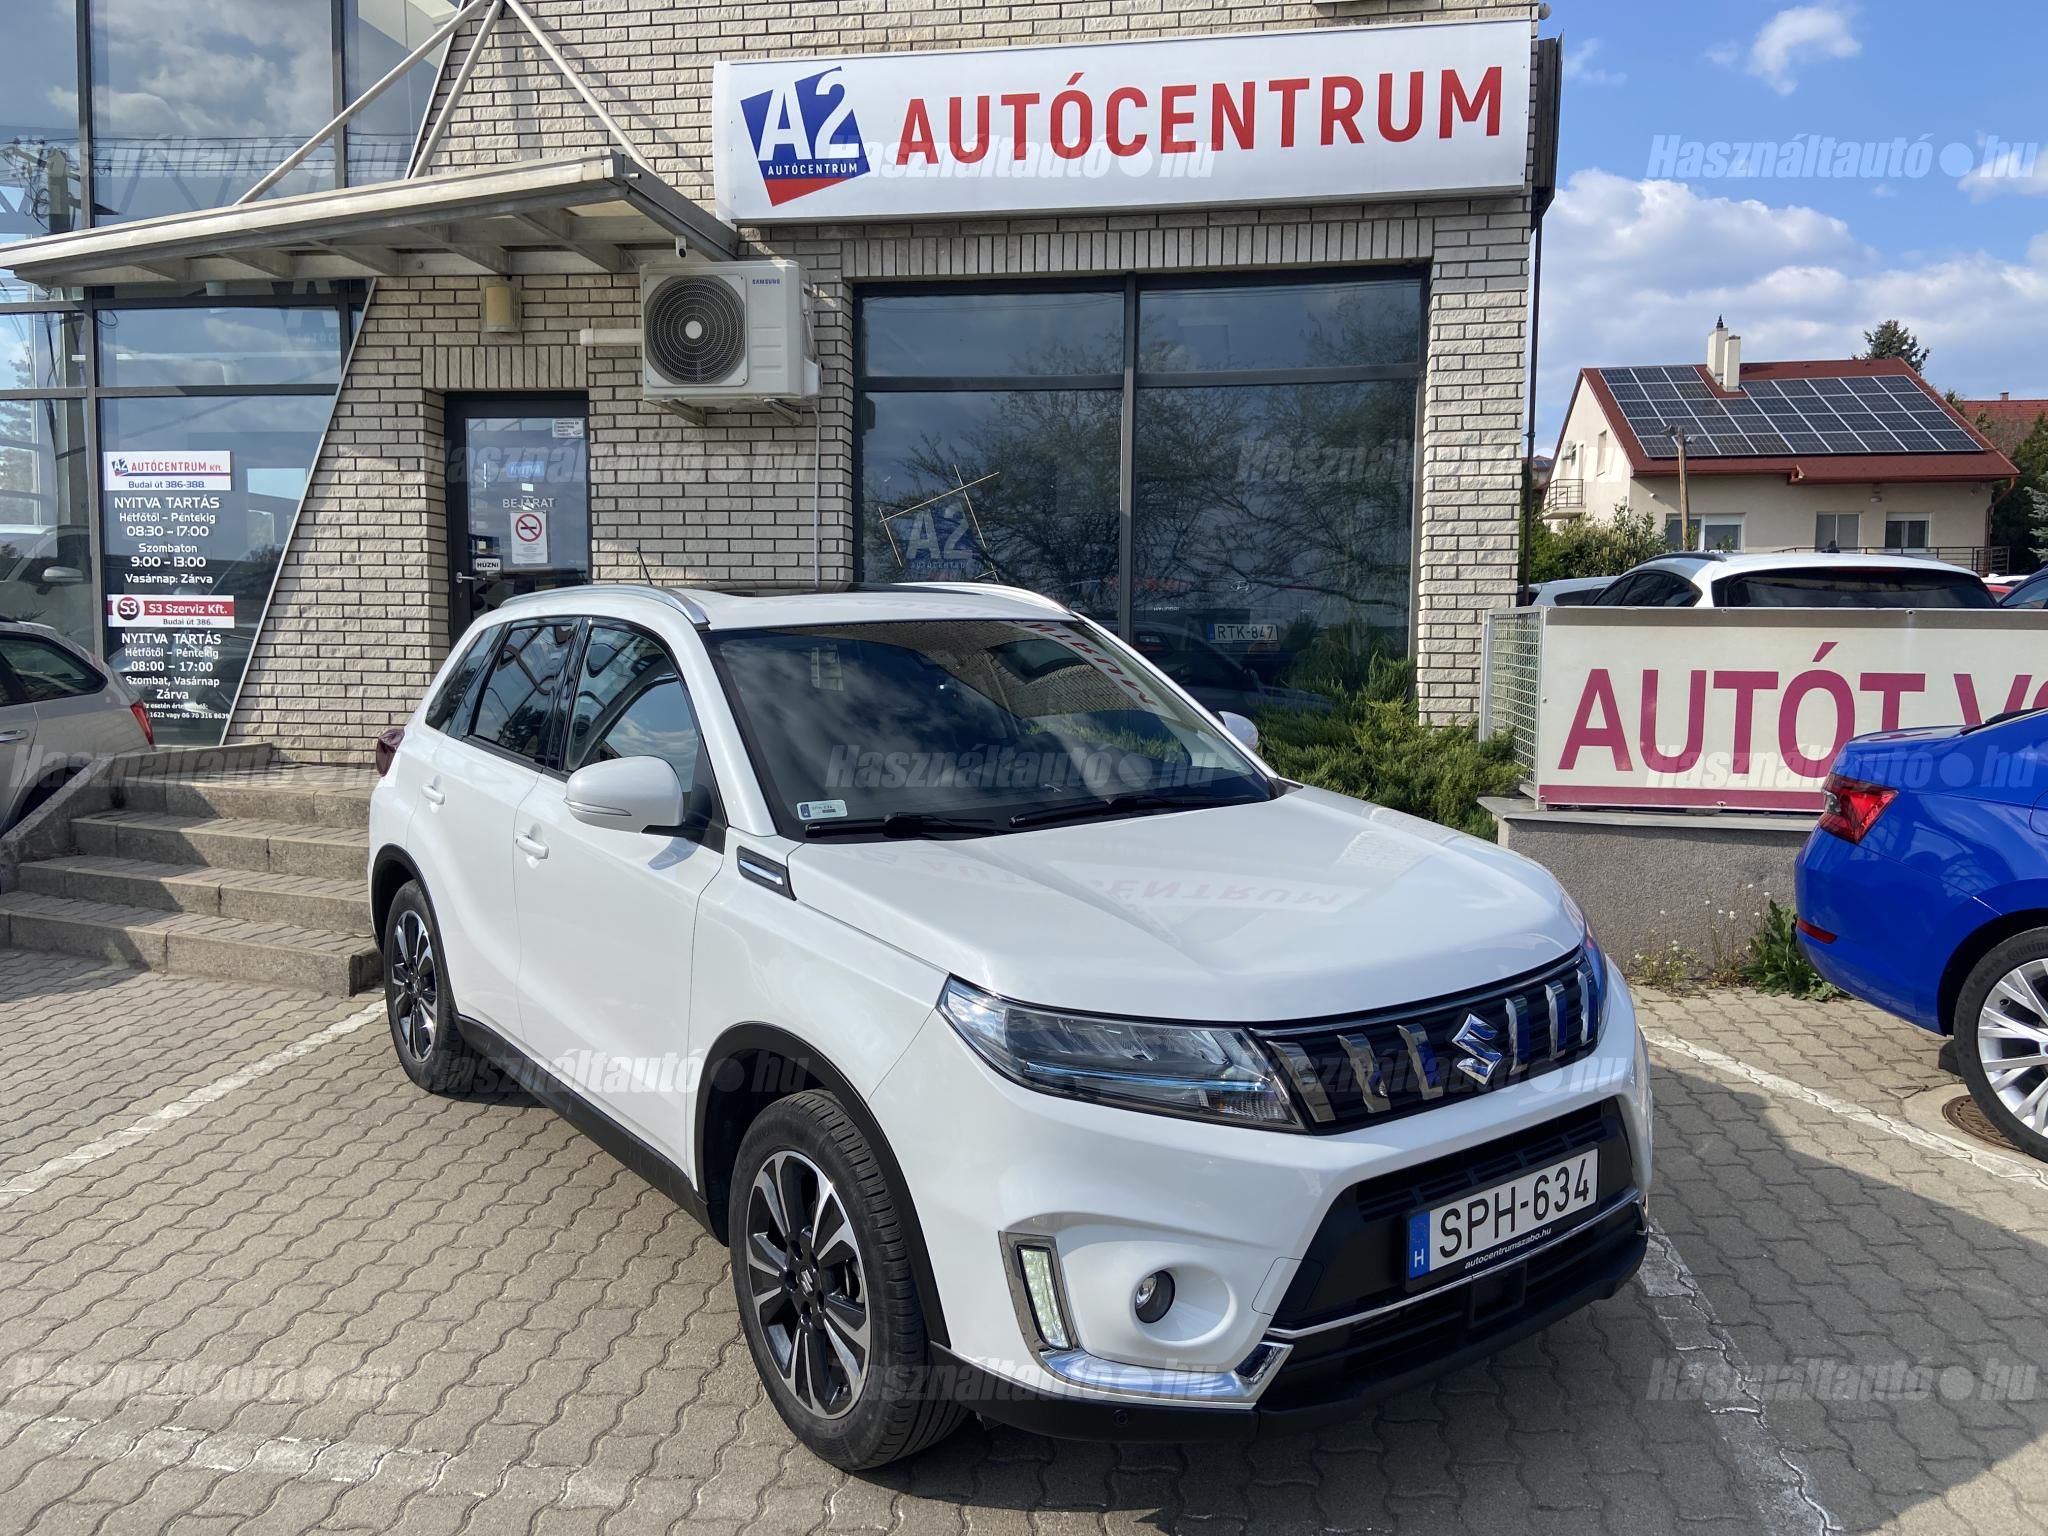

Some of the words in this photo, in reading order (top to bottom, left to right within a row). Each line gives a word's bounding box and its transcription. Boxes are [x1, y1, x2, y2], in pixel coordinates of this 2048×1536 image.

[757, 69, 861, 161] A2
[896, 66, 1503, 166] AUTÓCENTRUM
[768, 163, 858, 176] AUTÓCENTRUM
[131, 460, 207, 472] AUTÓCENTRUM
[128, 480, 153, 489] Budai
[154, 480, 163, 489] út
[114, 497, 161, 508] NYITVA
[166, 494, 220, 508] TARTÁS
[119, 512, 160, 522] Hétfőtől
[171, 512, 216, 524] Péntekig
[126, 526, 163, 536] 08:30
[177, 526, 209, 536] 17:00
[138, 543, 198, 553] Szombaton
[131, 556, 161, 567] 9:00
[174, 556, 206, 567] 13:00
[125, 573, 178, 585] Vasárnap:
[180, 573, 213, 584] Zárva
[148, 604, 163, 614] S3
[165, 604, 205, 614] Szerviz
[208, 604, 228, 614] Kft.
[163, 618, 185, 626] Budai
[121, 633, 168, 644] NYITVA
[173, 630, 222, 645] TARTÁS
[1217, 625, 1275, 640] RTK-847
[125, 648, 164, 657] Hétfőtől
[176, 648, 219, 659] Péntekig
[131, 661, 165, 671] 08:00
[180, 661, 213, 672] 17:00
[126, 675, 171, 686] Szombat,
[174, 676, 220, 688] Vasárnap
[156, 688, 189, 700] Zárva
[1558, 641, 1926, 778] AUTÓT
[1439, 1158, 1590, 1259] SPH-634
[1464, 1227, 1552, 1269] autocentrumszabo.hu
